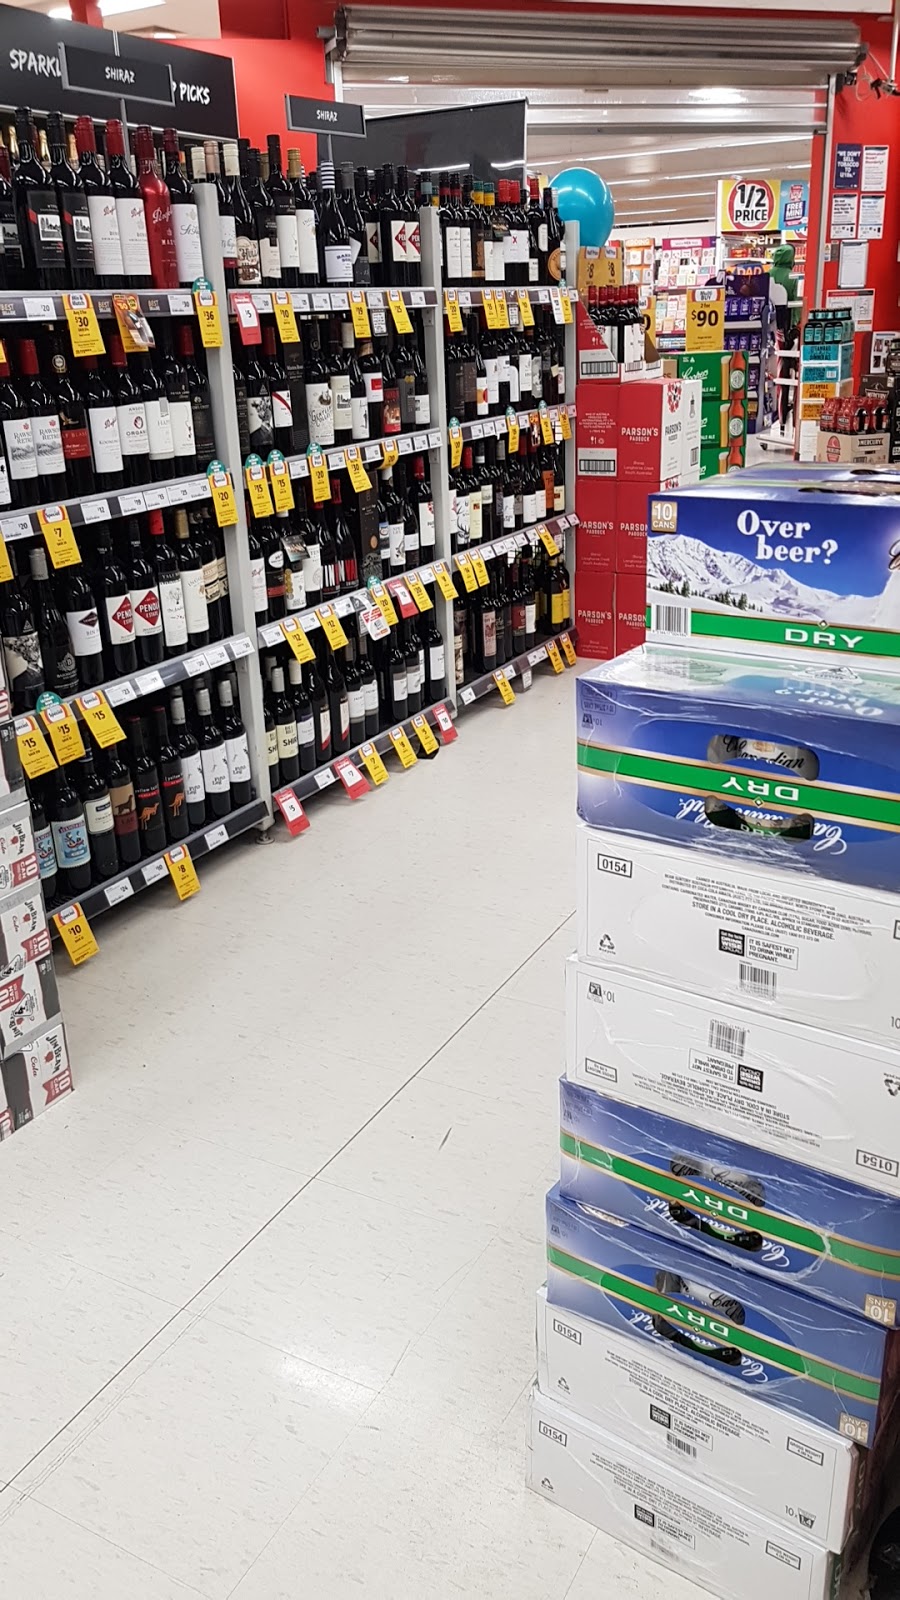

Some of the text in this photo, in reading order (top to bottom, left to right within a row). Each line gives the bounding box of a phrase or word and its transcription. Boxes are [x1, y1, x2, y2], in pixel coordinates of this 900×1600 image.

[105, 66, 135, 84] SHIRAZ
[180, 82, 210, 105] PICKS
[316, 109, 338, 122] SHIRAZ
[737, 184, 766, 208] 1/2
[785, 208, 803, 218] MINI
[787, 202, 803, 211] FREE
[735, 209, 768, 222] PRICE
[75, 316, 89, 327] $30
[204, 310, 214, 320] $36
[691, 310, 718, 326] $90
[621, 427, 658, 436] PARSON'S
[218, 492, 228, 501] $20
[655, 504, 672, 520] 10
[578, 521, 613, 530] PARSON'S
[653, 521, 674, 529] CANS
[737, 509, 810, 539] Over
[54, 528, 62, 538] $7
[755, 535, 838, 565] beer?
[578, 610, 612, 619] PARSON'S
[784, 628, 864, 649] DRY
[92, 711, 105, 720] $15
[16, 722, 29, 731] pecial
[58, 724, 70, 735] $15
[22, 738, 36, 748] $15
[721, 776, 799, 801] DRY
[13, 824, 24, 834] JIM
[25, 855, 37, 876] 10
[178, 864, 185, 873] $8
[602, 858, 627, 873] 0154
[25, 901, 34, 912] JIM
[692, 901, 709, 911] STORE
[722, 909, 736, 917] COOL
[738, 912, 748, 920] DRY
[750, 915, 769, 925] PLACE.
[770, 919, 802, 933] ALCOHOLIC
[803, 926, 835, 940] BEVERAGE.
[68, 925, 81, 936] $10
[38, 931, 50, 952] 10
[762, 942, 782, 951] SAFEST
[749, 951, 778, 963] PREGNANT.
[757, 947, 774, 955] DRINK
[775, 952, 792, 960] WHILE
[606, 991, 615, 1003] 10
[46, 1035, 63, 1074] JIM BEAM
[694, 1058, 709, 1068] WHILE
[707, 1056, 734, 1069] PREGNANT.
[710, 1064, 726, 1073] DRINK
[703, 1067, 721, 1077] SAFEST
[59, 1070, 70, 1092] 10
[660, 1073, 686, 1086] BEVERAGE.
[687, 1082, 714, 1097] ALCOHOLIC
[734, 1098, 744, 1106] DRY
[745, 1101, 759, 1110] COOL
[773, 1110, 790, 1120] STORE
[863, 1154, 892, 1172] 0154
[682, 1188, 748, 1221] DRY
[869, 1296, 894, 1307] CANS
[665, 1304, 729, 1336] DRY
[869, 1308, 893, 1324] 10
[557, 1324, 577, 1340] 0154
[542, 1426, 563, 1442] 0154
[844, 1424, 865, 1440] 10
[785, 1505, 794, 1518] 10
